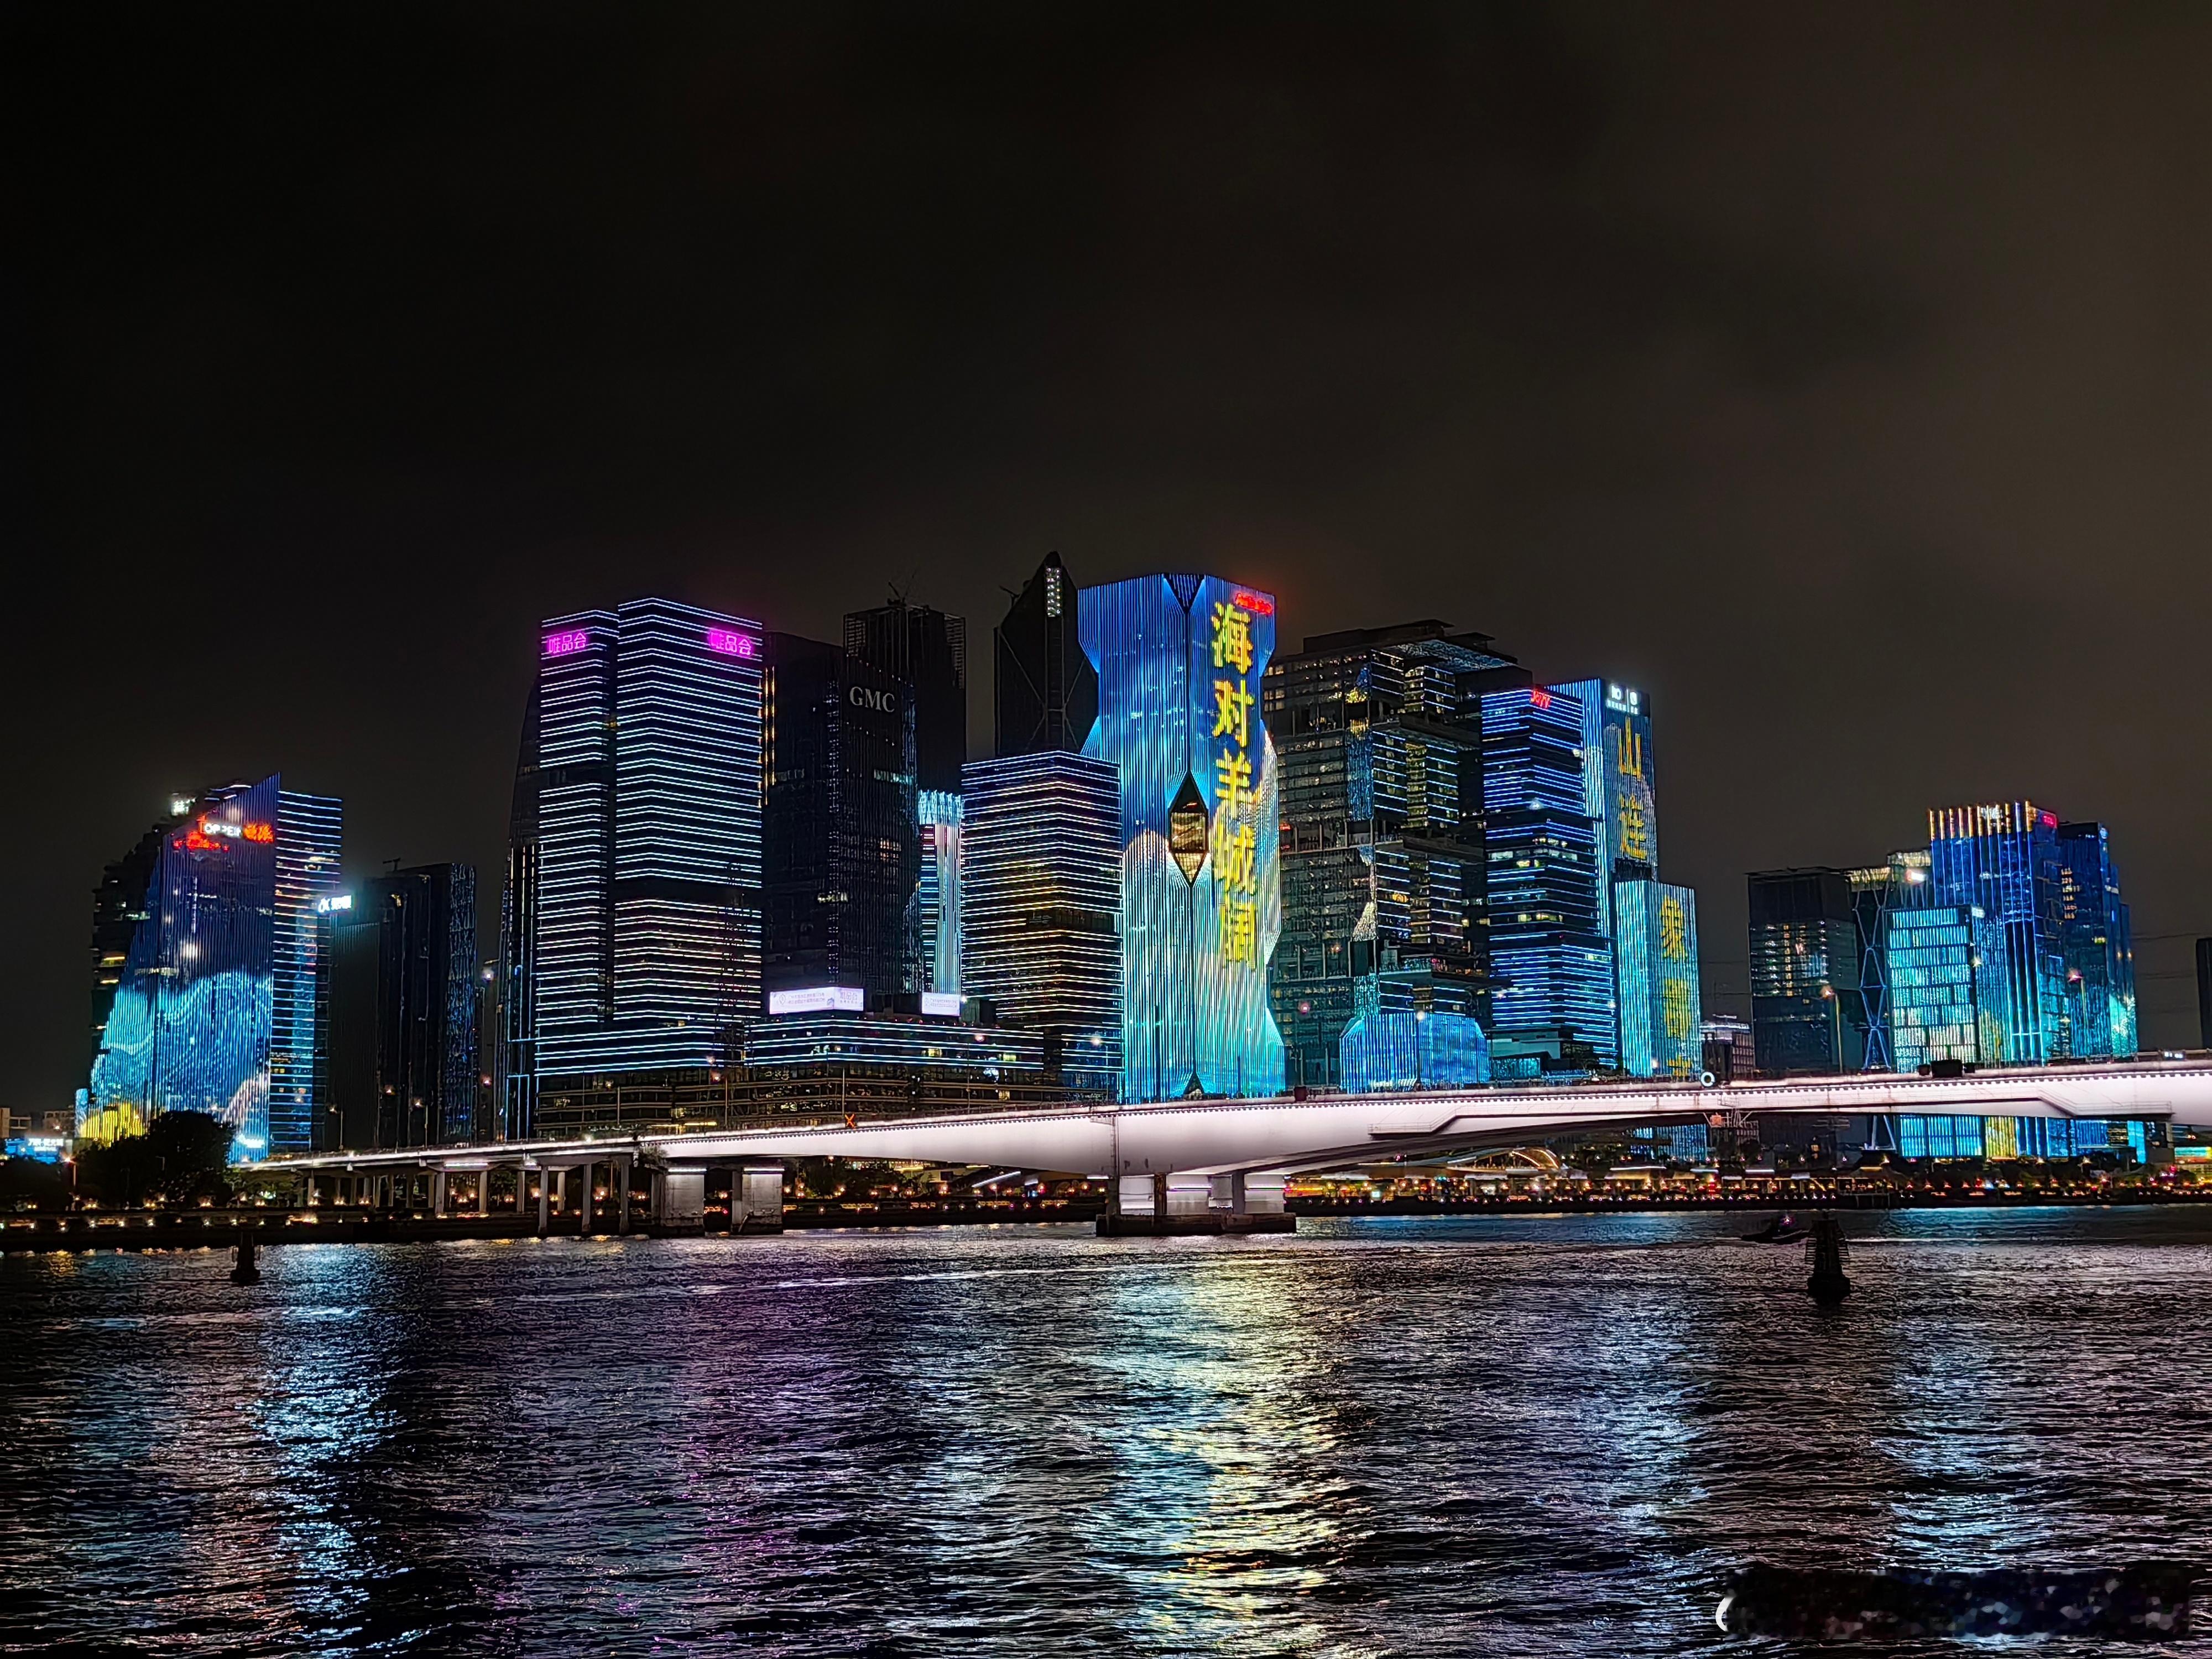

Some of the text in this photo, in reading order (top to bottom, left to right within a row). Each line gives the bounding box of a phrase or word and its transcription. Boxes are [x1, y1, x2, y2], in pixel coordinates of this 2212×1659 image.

[547, 632, 586, 654] 唯品会
[709, 631, 752, 656] 唯品会
[849, 686, 895, 713] GMC
